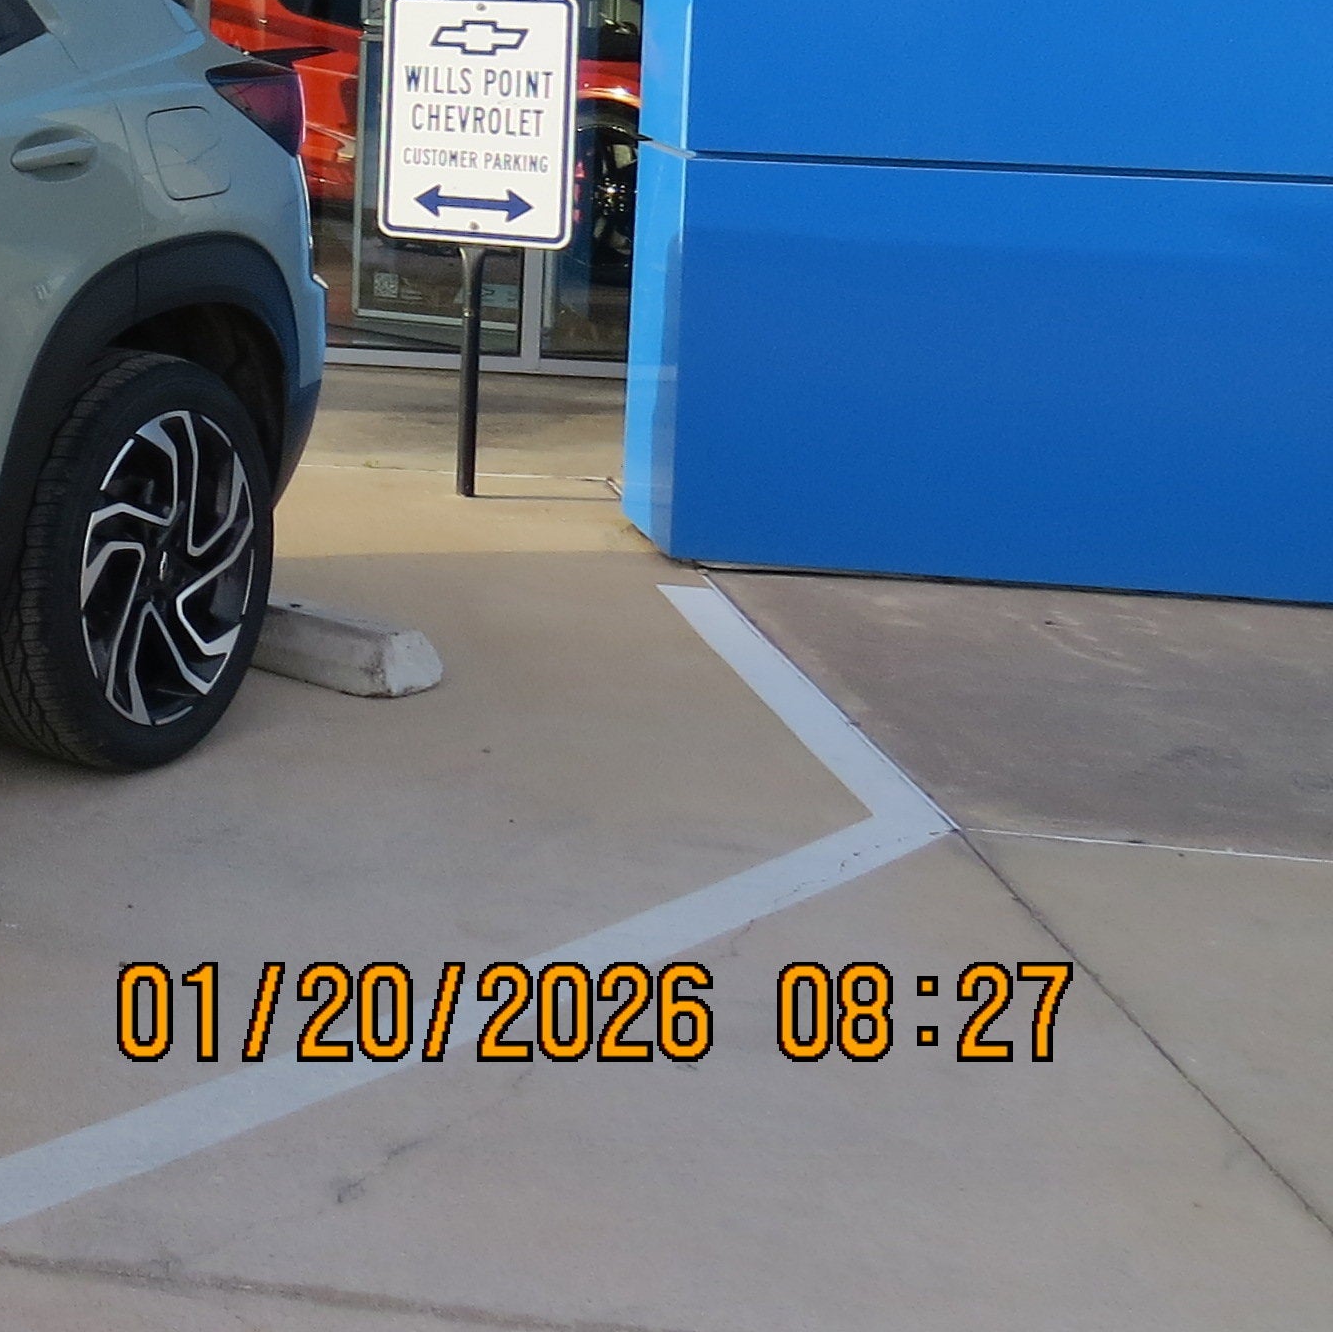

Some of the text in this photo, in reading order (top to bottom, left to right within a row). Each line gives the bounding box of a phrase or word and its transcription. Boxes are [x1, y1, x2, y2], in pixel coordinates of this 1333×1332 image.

[404, 65, 553, 99] WILLS POINT
[411, 103, 544, 137] CHEVROLET
[403, 147, 549, 173] CUSTOMER PARKING
